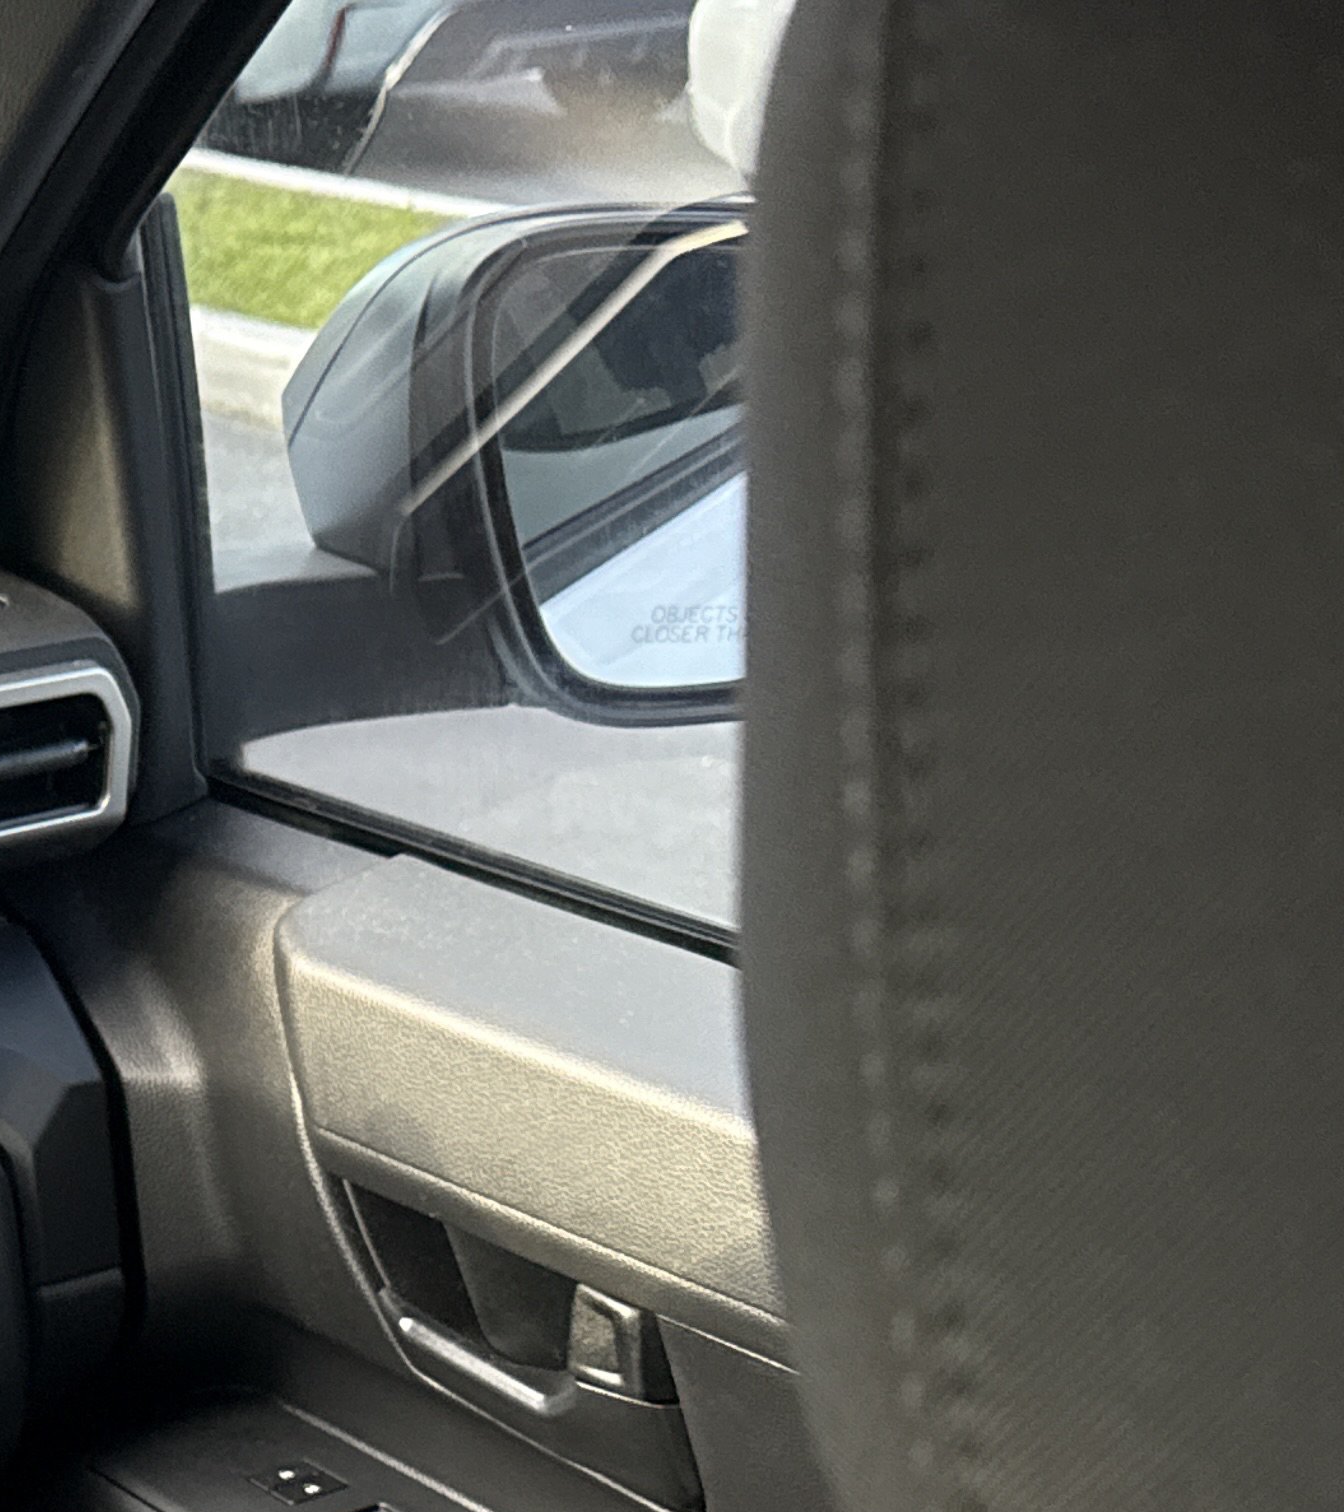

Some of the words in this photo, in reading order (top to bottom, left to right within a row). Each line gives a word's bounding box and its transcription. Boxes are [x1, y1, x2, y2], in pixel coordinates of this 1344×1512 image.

[650, 604, 739, 624] OBJECTS
[630, 624, 711, 644] CLOSER
[716, 625, 745, 643] TH
